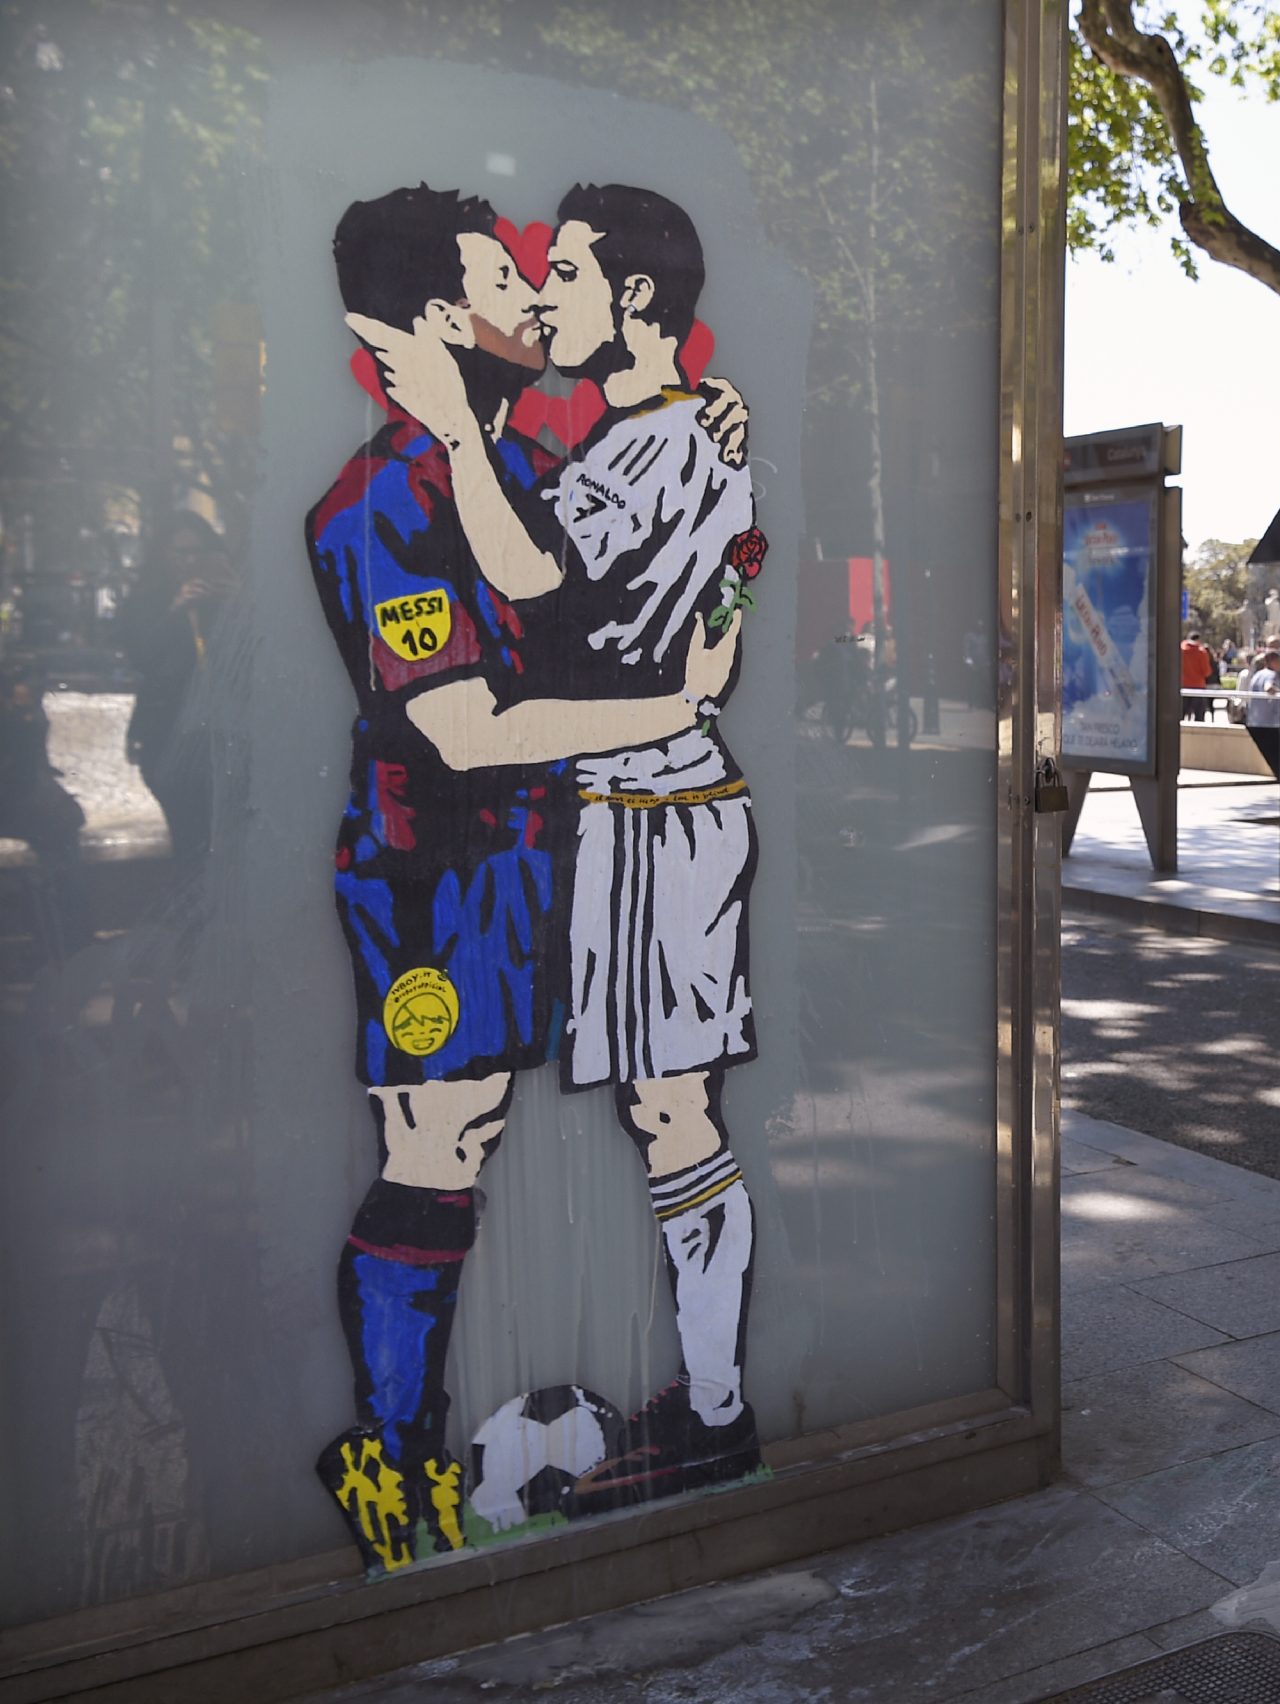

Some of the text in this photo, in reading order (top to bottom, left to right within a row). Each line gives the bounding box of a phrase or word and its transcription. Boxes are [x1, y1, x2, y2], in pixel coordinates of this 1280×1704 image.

[576, 473, 626, 509] RONALDO
[380, 596, 443, 627] MESSI
[401, 627, 437, 656] 10
